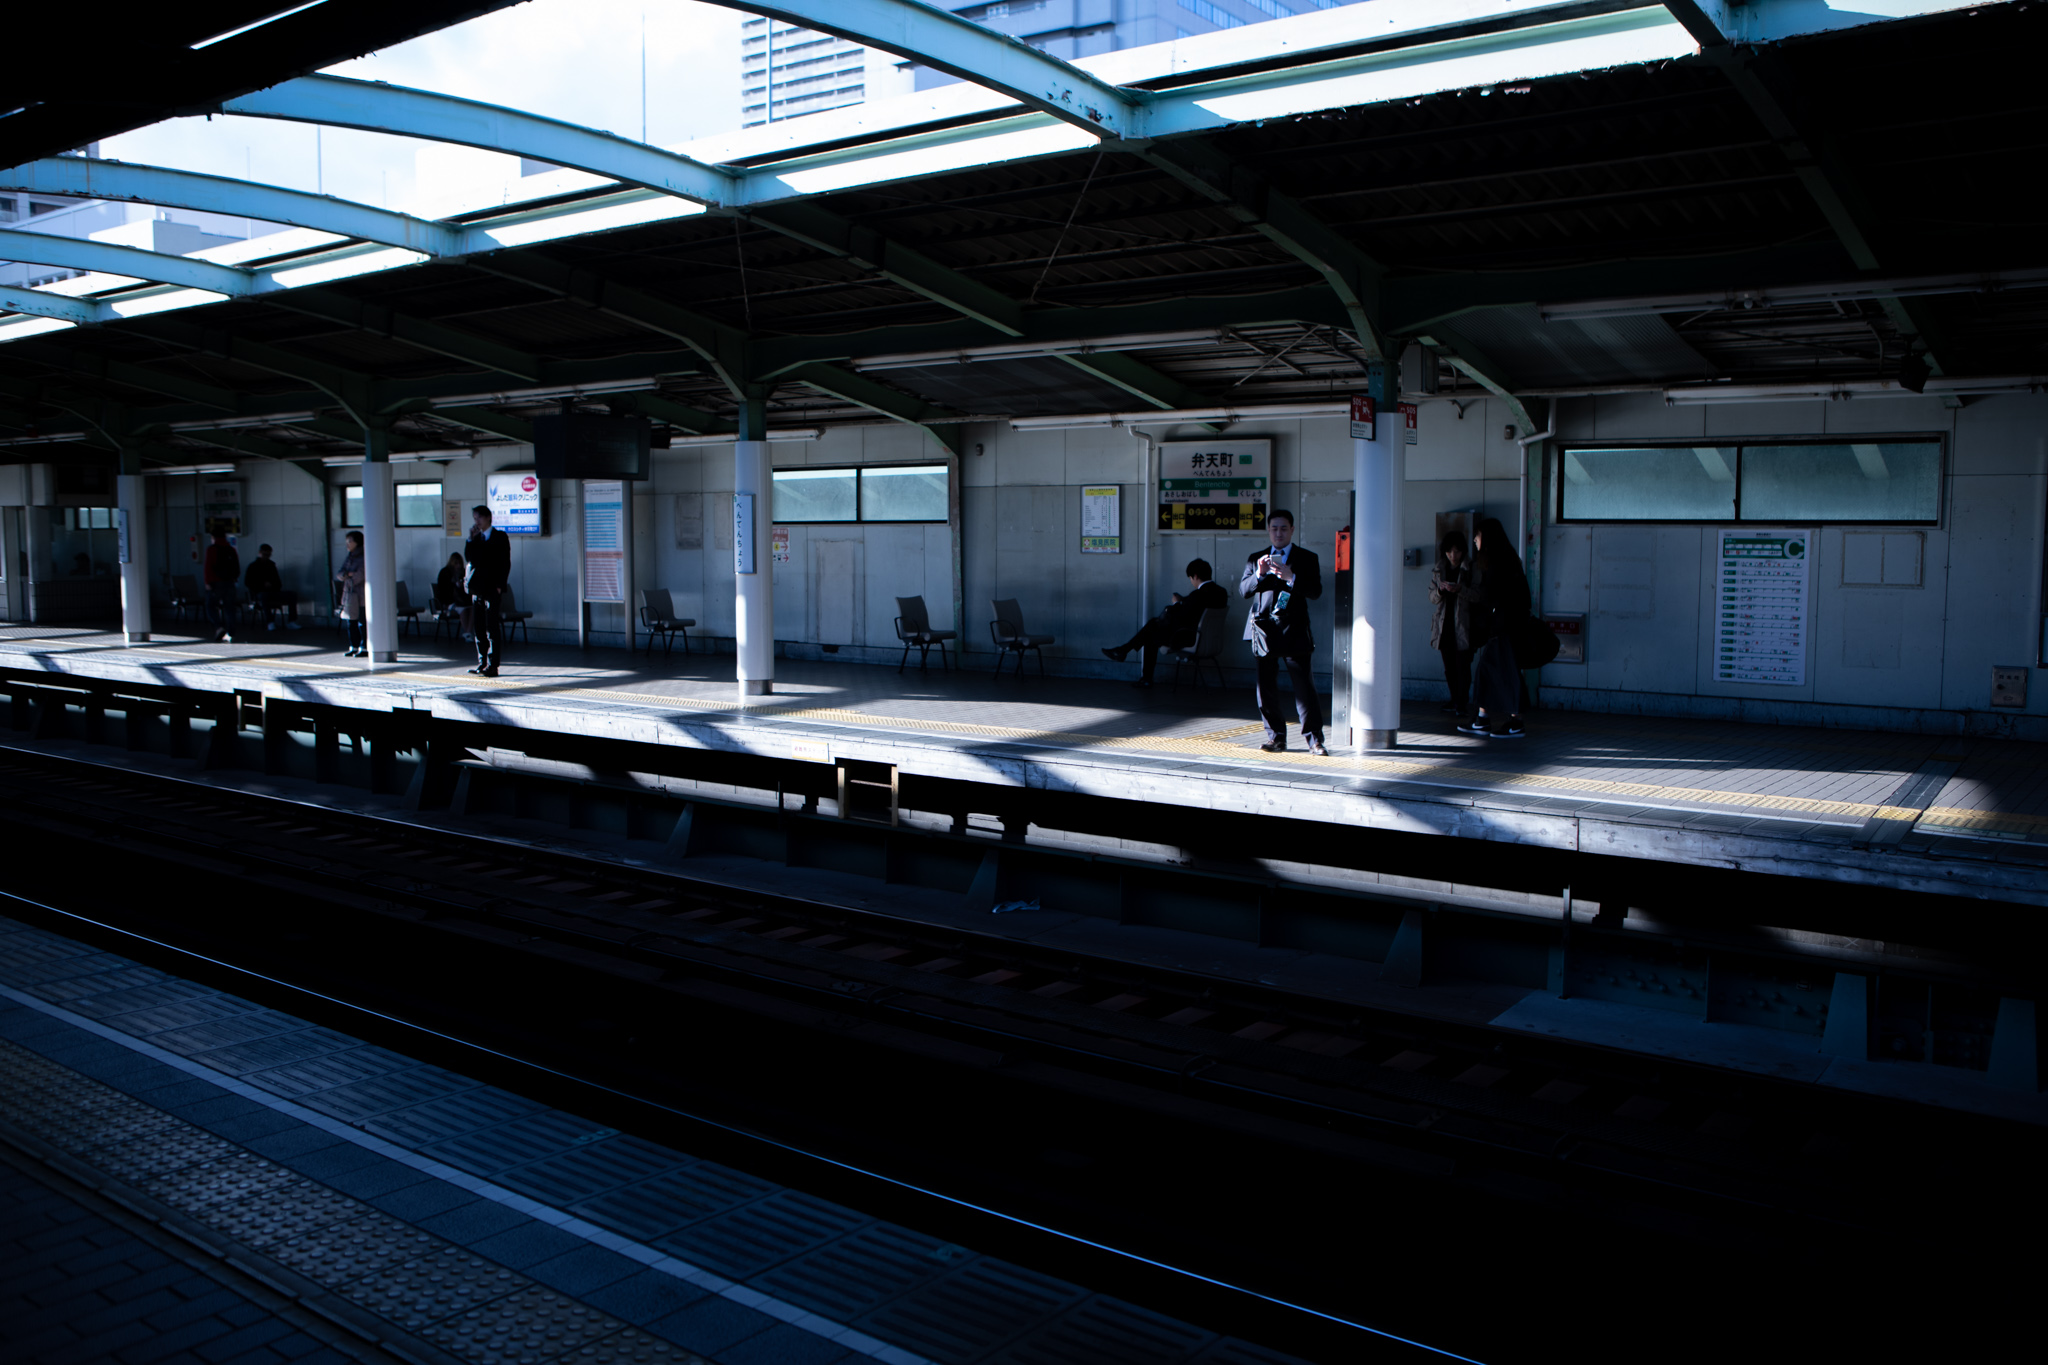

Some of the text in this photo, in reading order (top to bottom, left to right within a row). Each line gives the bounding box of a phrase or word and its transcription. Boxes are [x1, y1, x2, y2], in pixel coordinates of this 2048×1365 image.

[1352, 397, 1362, 406] SOS
[1406, 406, 1416, 415] SOS
[1192, 453, 1233, 468] 弁天町
[1194, 480, 1230, 488] Bentencho
[1784, 538, 1804, 559] C
